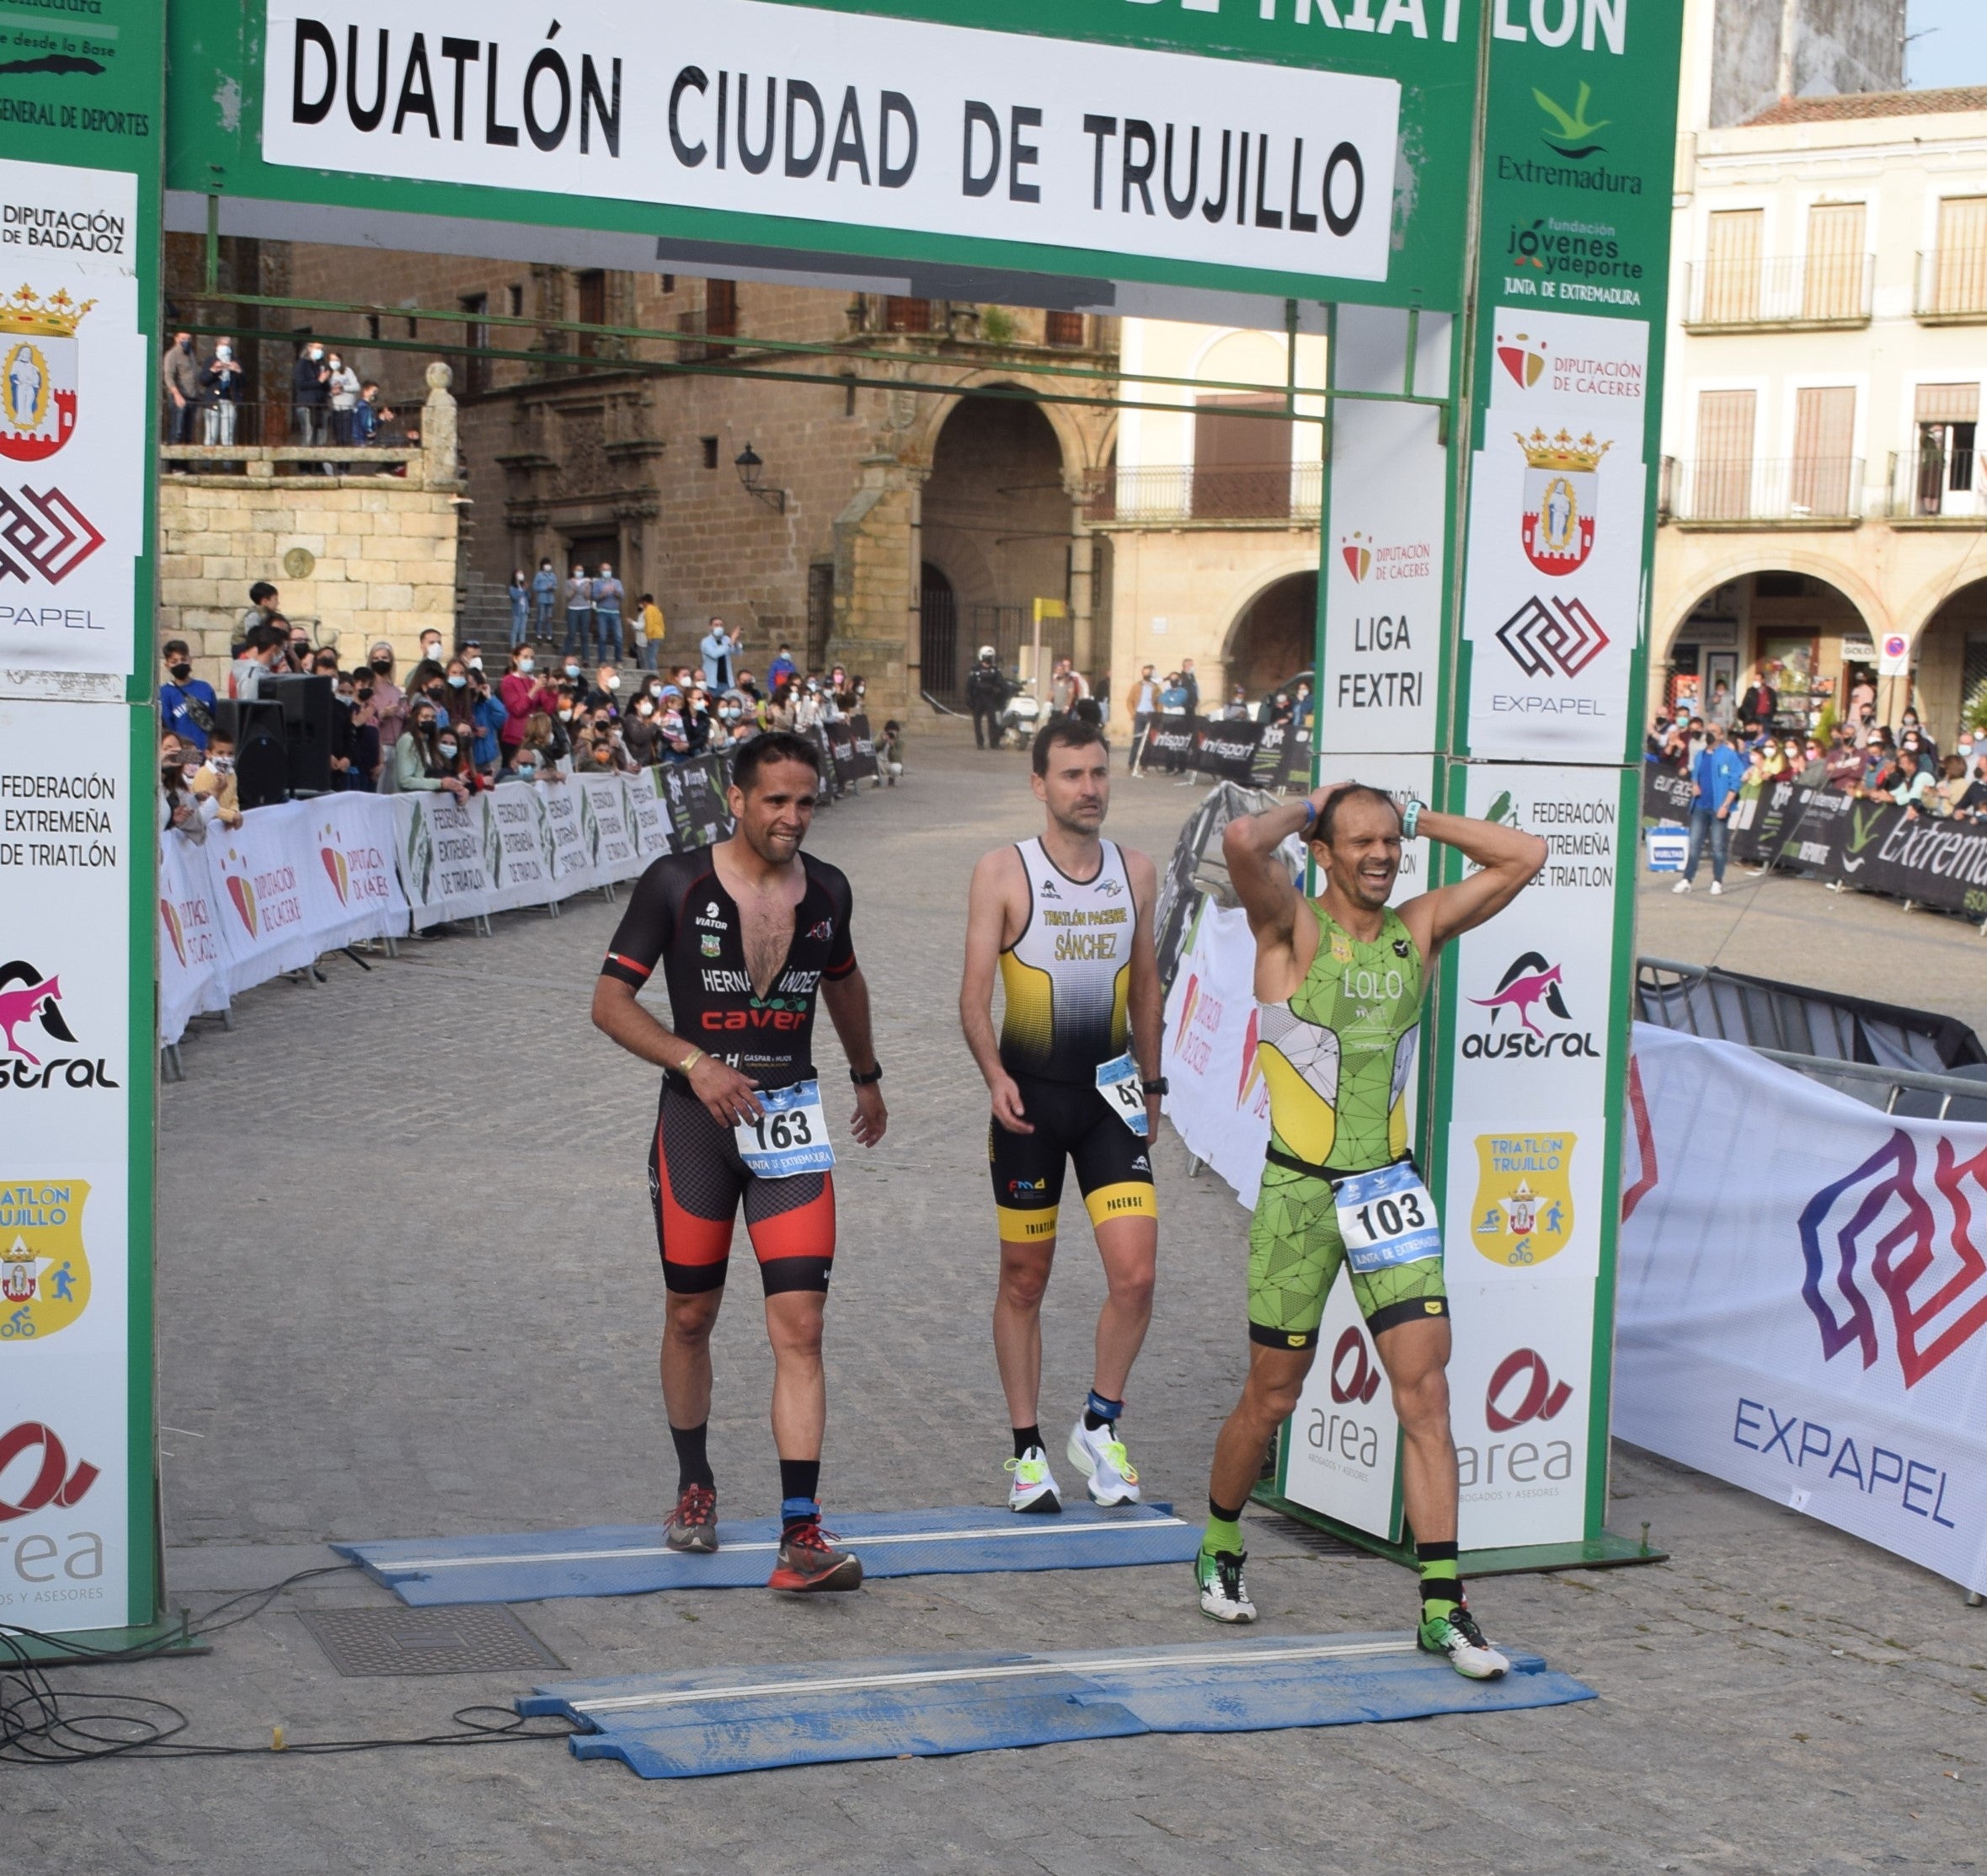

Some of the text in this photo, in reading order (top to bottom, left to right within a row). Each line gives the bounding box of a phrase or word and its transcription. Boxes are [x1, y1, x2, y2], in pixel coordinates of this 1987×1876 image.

[13, 33, 57, 51] desde
[62, 38, 77, 52] la
[83, 41, 116, 56] Base
[0, 98, 150, 136] ENERAL DE DEPORTES
[292, 19, 1365, 238] DUATLÓN CIUDAD DE TRUJILLO
[1497, 155, 1642, 195] Extremadura
[3, 205, 125, 235] DIPUTACIÓN
[1547, 217, 1616, 237] fundación
[3, 228, 124, 254] DE BADAJOZ
[1508, 219, 1619, 259] jóvenes
[1504, 277, 1641, 305] JUNTA DE EXTREMADURA
[1553, 357, 1642, 378] DIPUTACIÓN
[1552, 376, 1571, 392] DE
[1376, 542, 1429, 563] DIPUTACIÓN
[1375, 565, 1387, 581] DE
[1354, 614, 1412, 652] LIGA
[1338, 671, 1423, 708] FEXTRI
[1492, 694, 1606, 717] EXPAPEL
[2, 772, 115, 800] FEDERACIÓN
[5, 808, 112, 834] EXTREMEÑA
[1533, 799, 1615, 825] FEDERACIÓN
[0, 840, 116, 868] DE TRIATLÓN
[1535, 832, 1610, 856] TREMEÑA
[695, 916, 729, 931] VIATOR
[1043, 908, 1087, 927] TRIATLÓN
[1055, 928, 1118, 961] SÁNCHEZ
[1343, 969, 1403, 1000] LOLO
[701, 1009, 807, 1032] caver
[744, 1054, 772, 1062] GASPAR
[1461, 1033, 1601, 1059] austral
[752, 1109, 813, 1151] 163
[1491, 1135, 1563, 1155] TRIATLÓN
[781, 1151, 831, 1168] EXTREMADURA
[1493, 1157, 1560, 1173] TRUJILLO
[1107, 1196, 1143, 1211] PACENSE
[1356, 1193, 1425, 1241] 103
[1354, 1253, 1380, 1264] JUNTA
[1382, 1248, 1395, 1260] DE
[1307, 1408, 1379, 1468] area
[1458, 1440, 1573, 1488] area
[1733, 1398, 1956, 1530] EXPAPEL
[1459, 1491, 1504, 1503] BOGADOS
[1515, 1487, 1560, 1499] ASESORES
[35, 1587, 103, 1603] ASESORES
